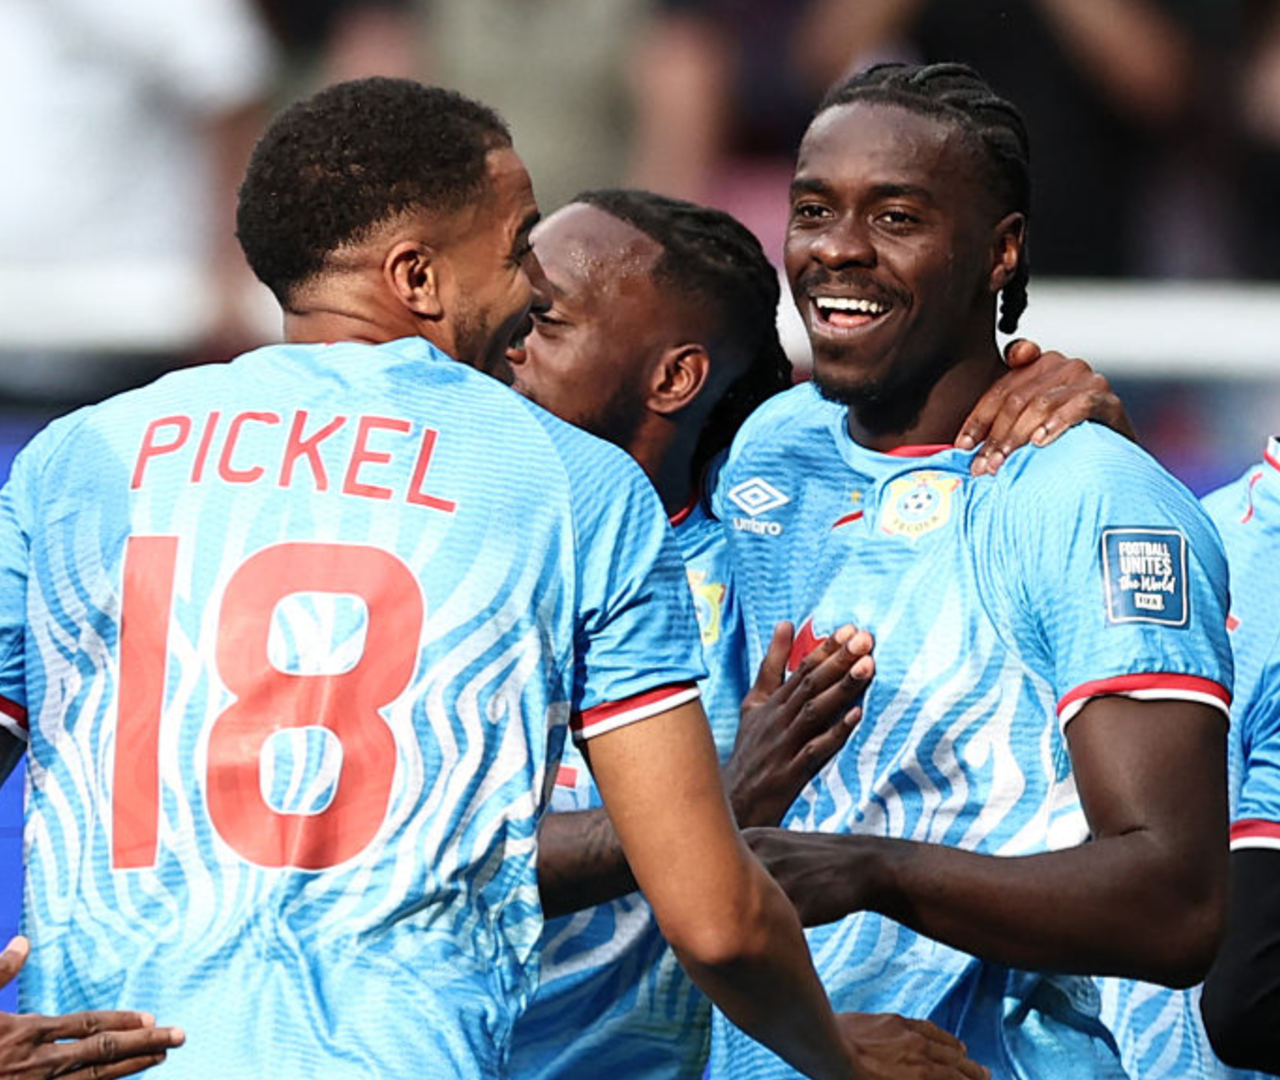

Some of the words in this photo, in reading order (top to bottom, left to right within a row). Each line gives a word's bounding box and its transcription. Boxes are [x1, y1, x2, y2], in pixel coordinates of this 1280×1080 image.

[130, 409, 457, 513] PICKEL
[1120, 556, 1172, 576] UNITES
[111, 536, 425, 871] 18
